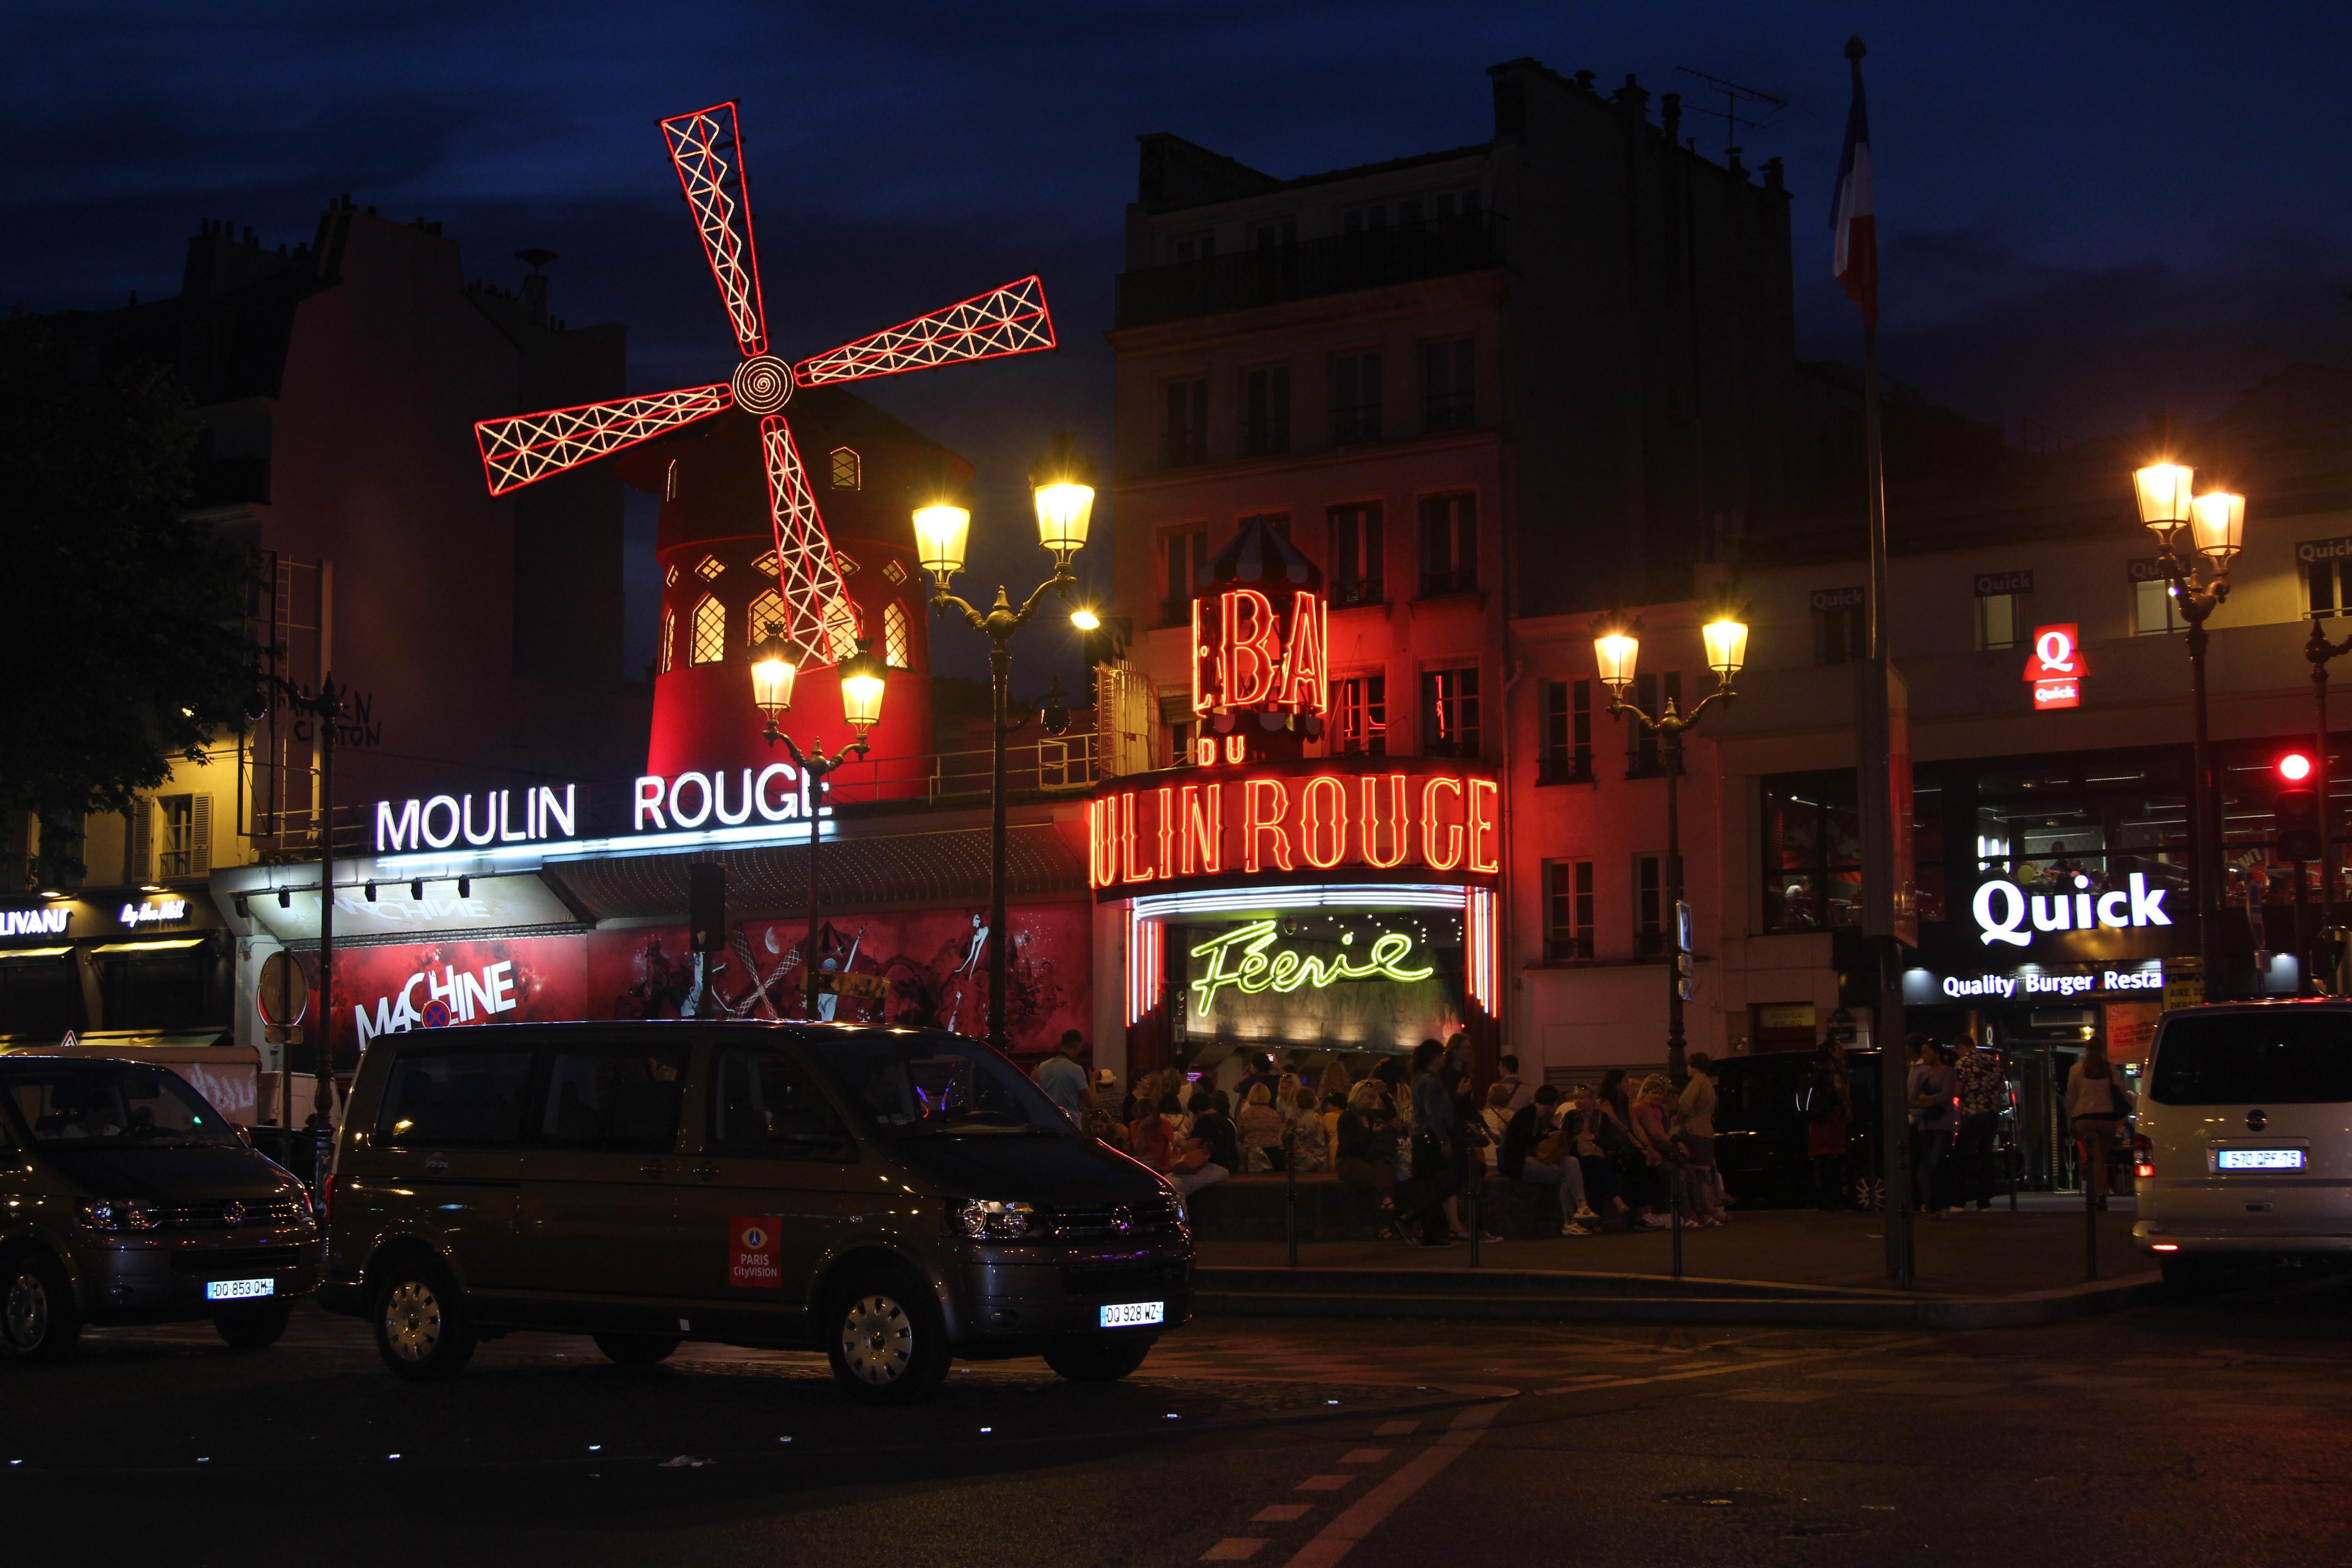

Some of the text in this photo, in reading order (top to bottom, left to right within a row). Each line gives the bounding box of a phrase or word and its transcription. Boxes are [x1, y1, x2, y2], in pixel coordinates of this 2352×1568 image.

[2132, 559, 2187, 579] Quk
[1977, 572, 2031, 594] Quick
[1813, 590, 1863, 610] Quick
[2036, 631, 2073, 672] Q
[2035, 686, 2076, 703] Quick
[1197, 735, 1245, 766] DU
[376, 783, 576, 851] MOULIN
[1090, 774, 1499, 888] ULIN ROUGE
[120, 900, 185, 927] By the Mill
[1972, 872, 2174, 947] Quick
[1943, 974, 2015, 998] Quality
[2025, 972, 2094, 996] Burger
[2170, 988, 2189, 997] AIRE
[355, 960, 517, 1051] MACHINE
[2231, 1153, 2252, 1166] 570
[2283, 1152, 2297, 1166] 75
[741, 1254, 769, 1265] PARIS
[734, 1266, 777, 1278] CityVISION
